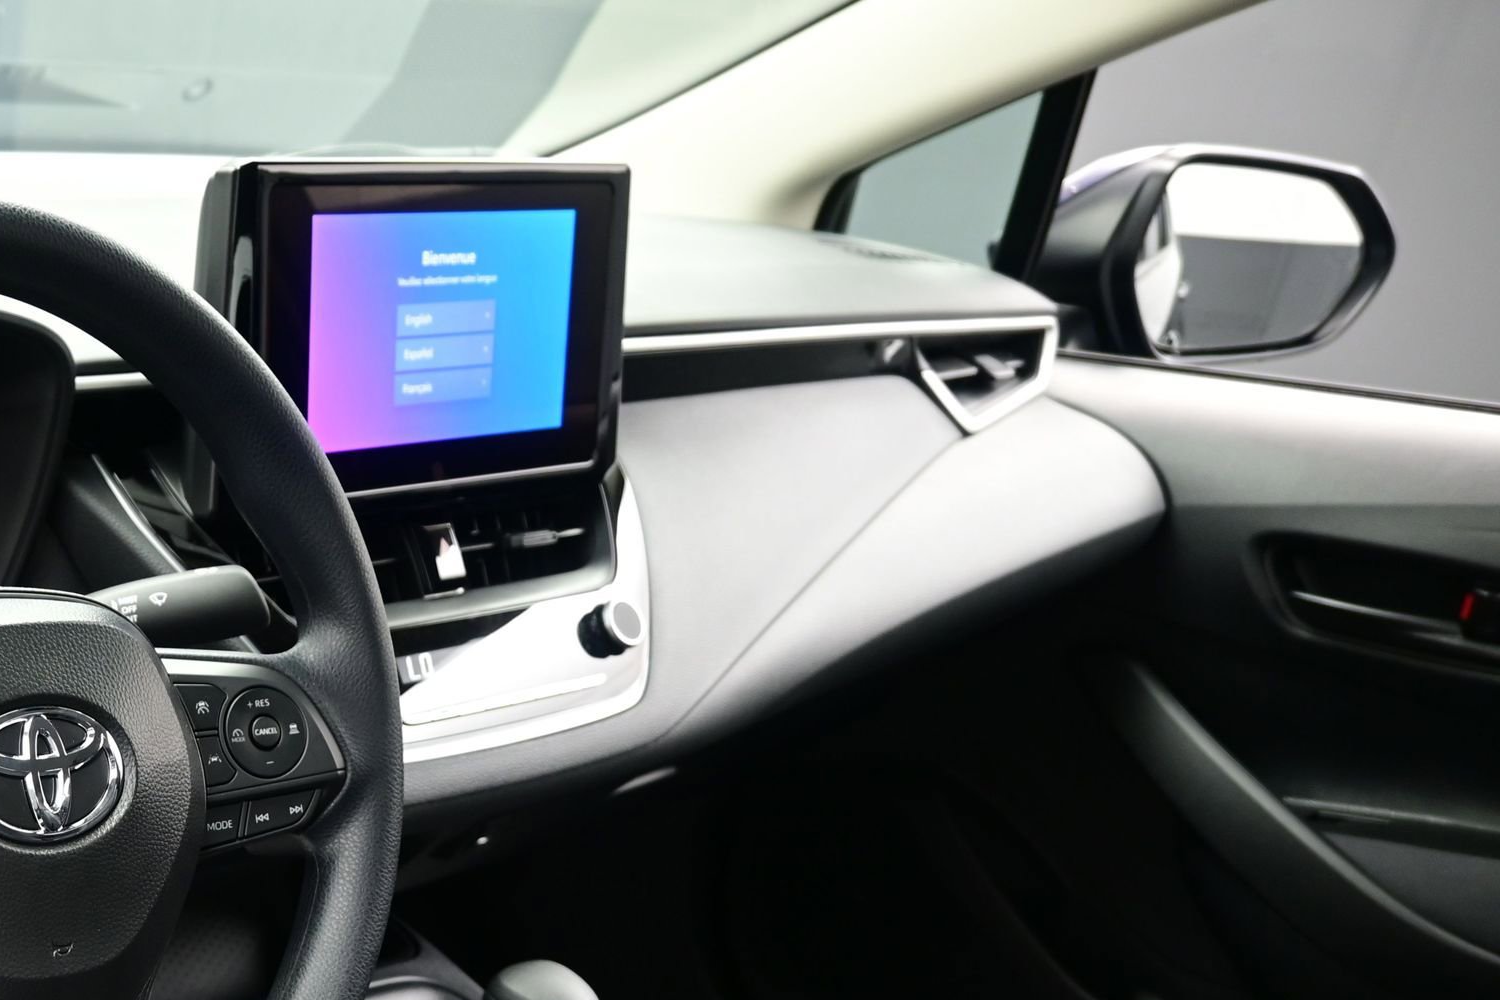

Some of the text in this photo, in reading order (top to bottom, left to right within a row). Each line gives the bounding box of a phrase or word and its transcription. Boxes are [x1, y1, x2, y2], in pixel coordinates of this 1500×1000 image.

[421, 250, 477, 267] Bienvenue
[255, 698, 270, 708] RES
[254, 727, 278, 736] CANCEL
[207, 819, 233, 832] MODE
